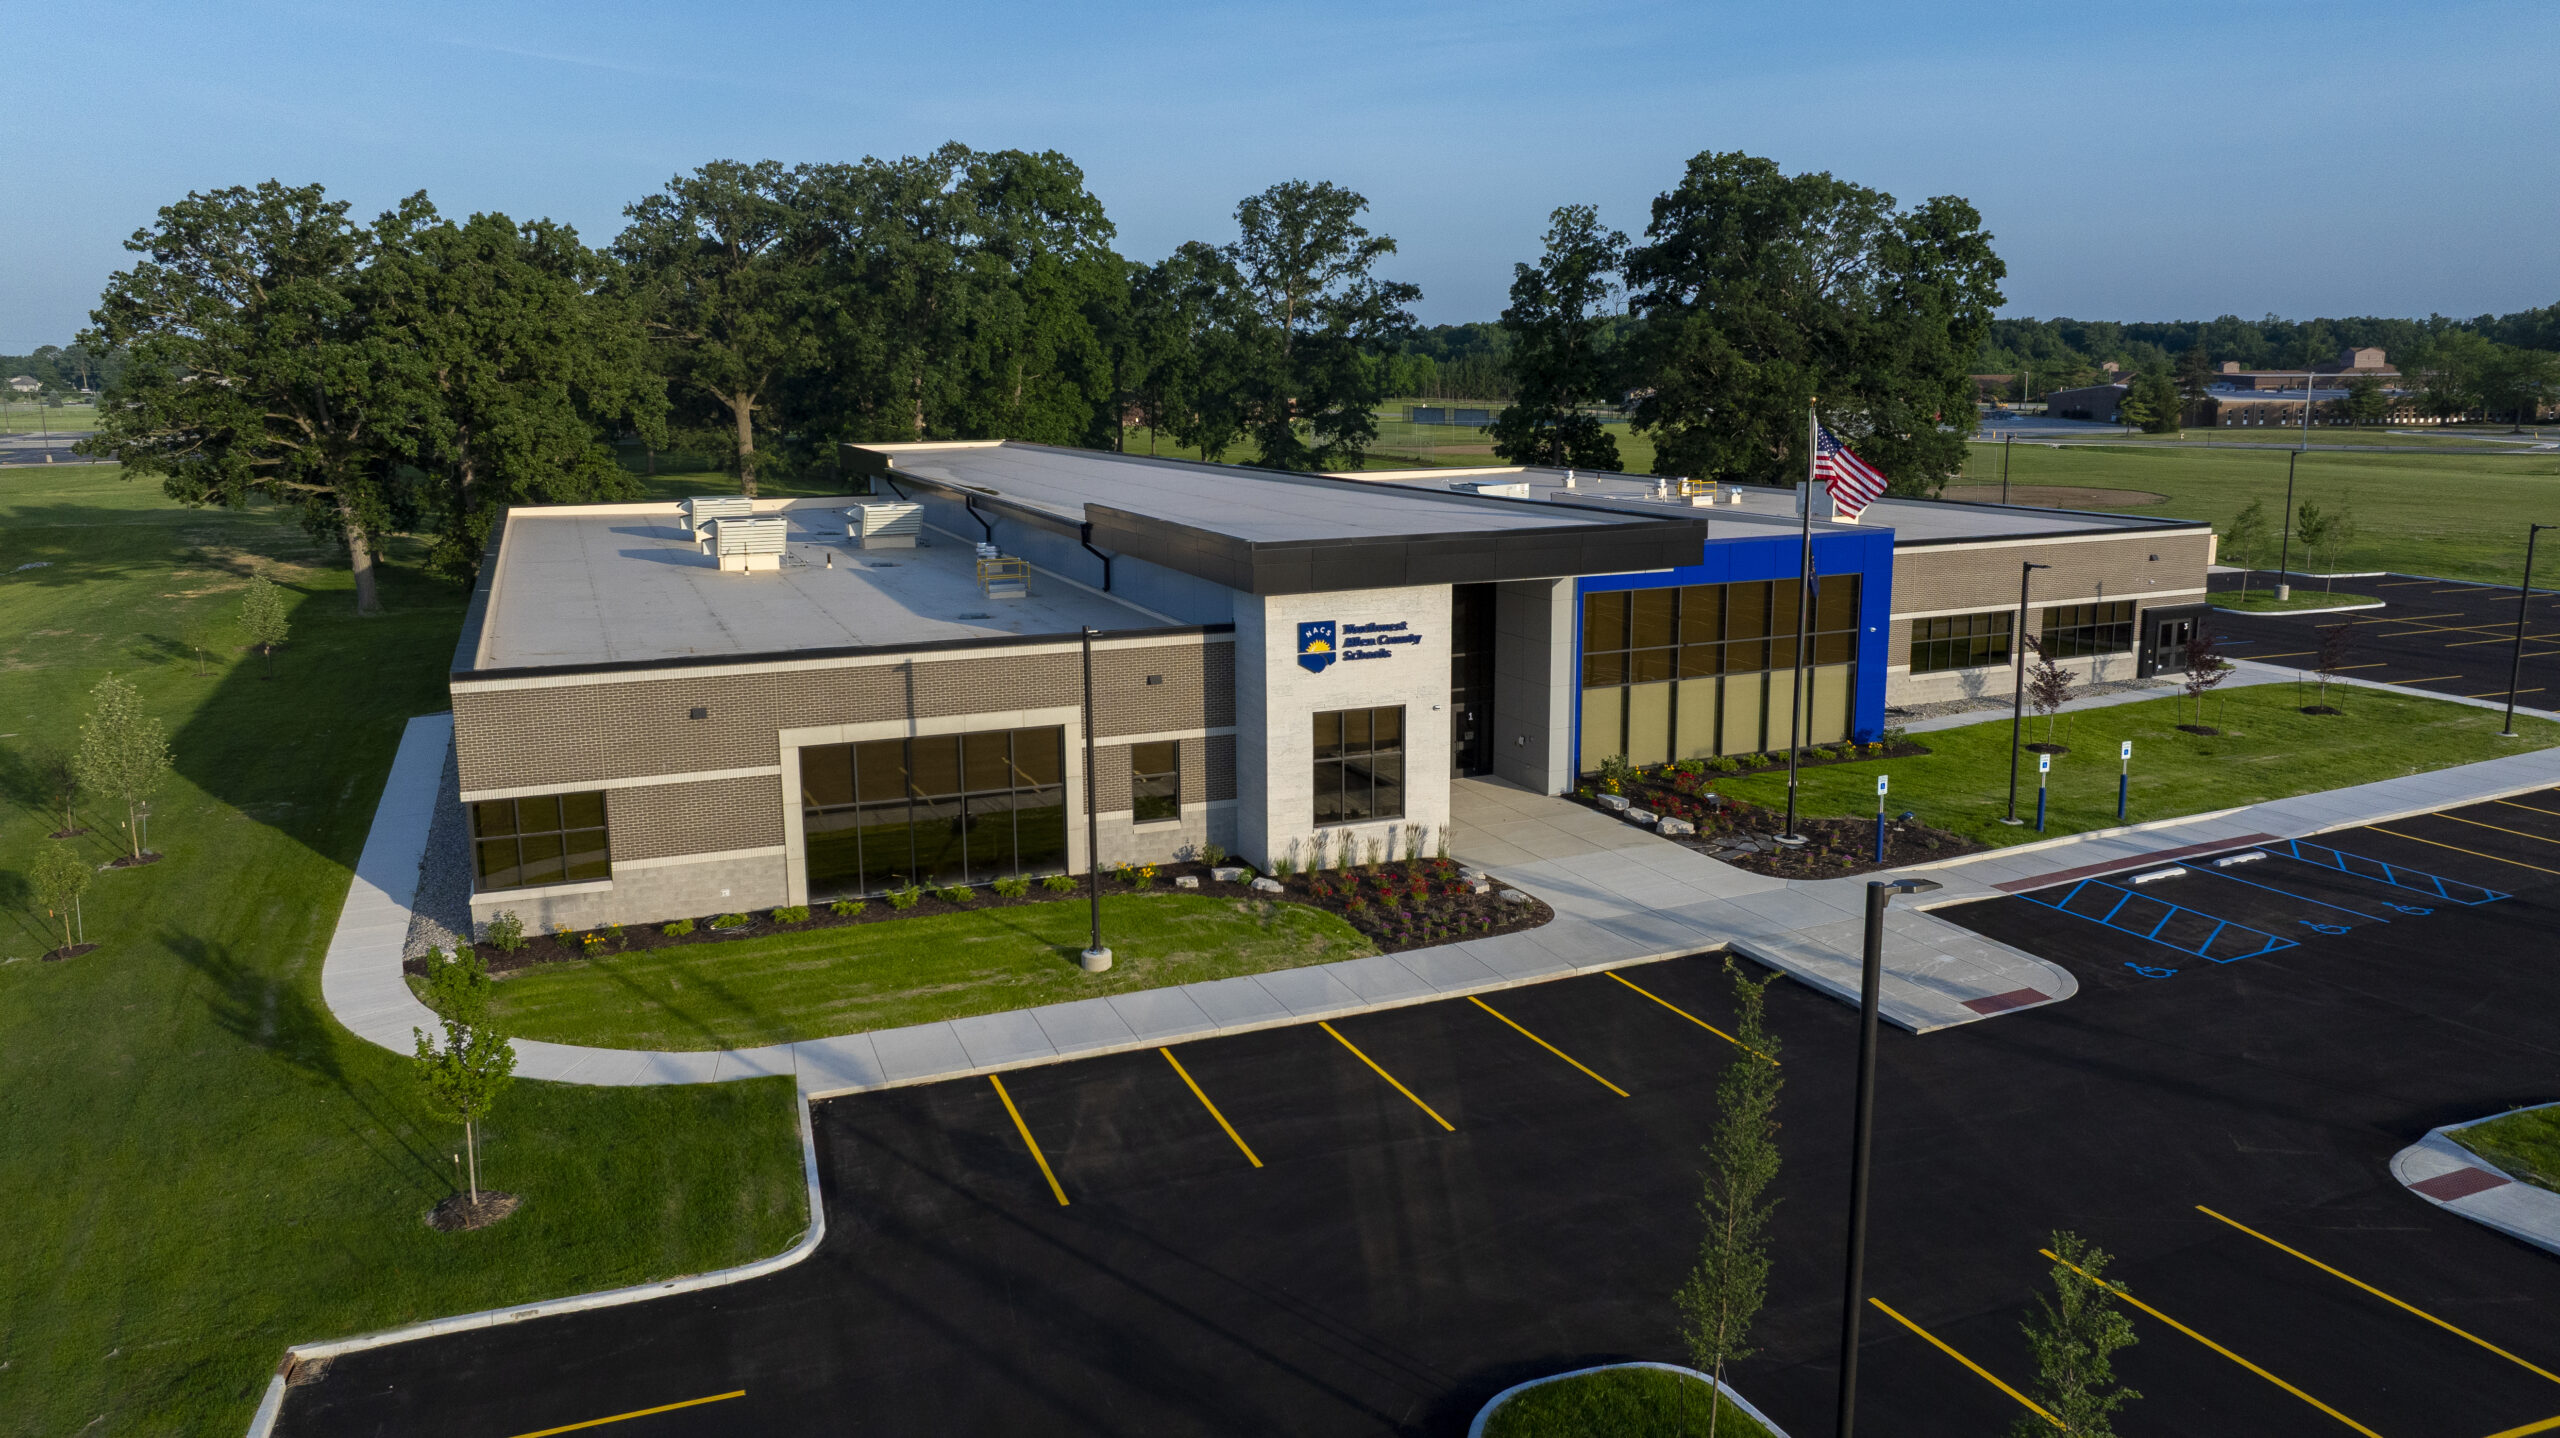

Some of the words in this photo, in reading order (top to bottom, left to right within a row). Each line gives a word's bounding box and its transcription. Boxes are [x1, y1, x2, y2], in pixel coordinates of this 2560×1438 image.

[1305, 627, 1332, 638] NACS
[1342, 621, 1408, 635] Northwest
[1342, 637, 1376, 648] Allen
[1377, 634, 1422, 645] County
[1342, 648, 1392, 661] Schools
